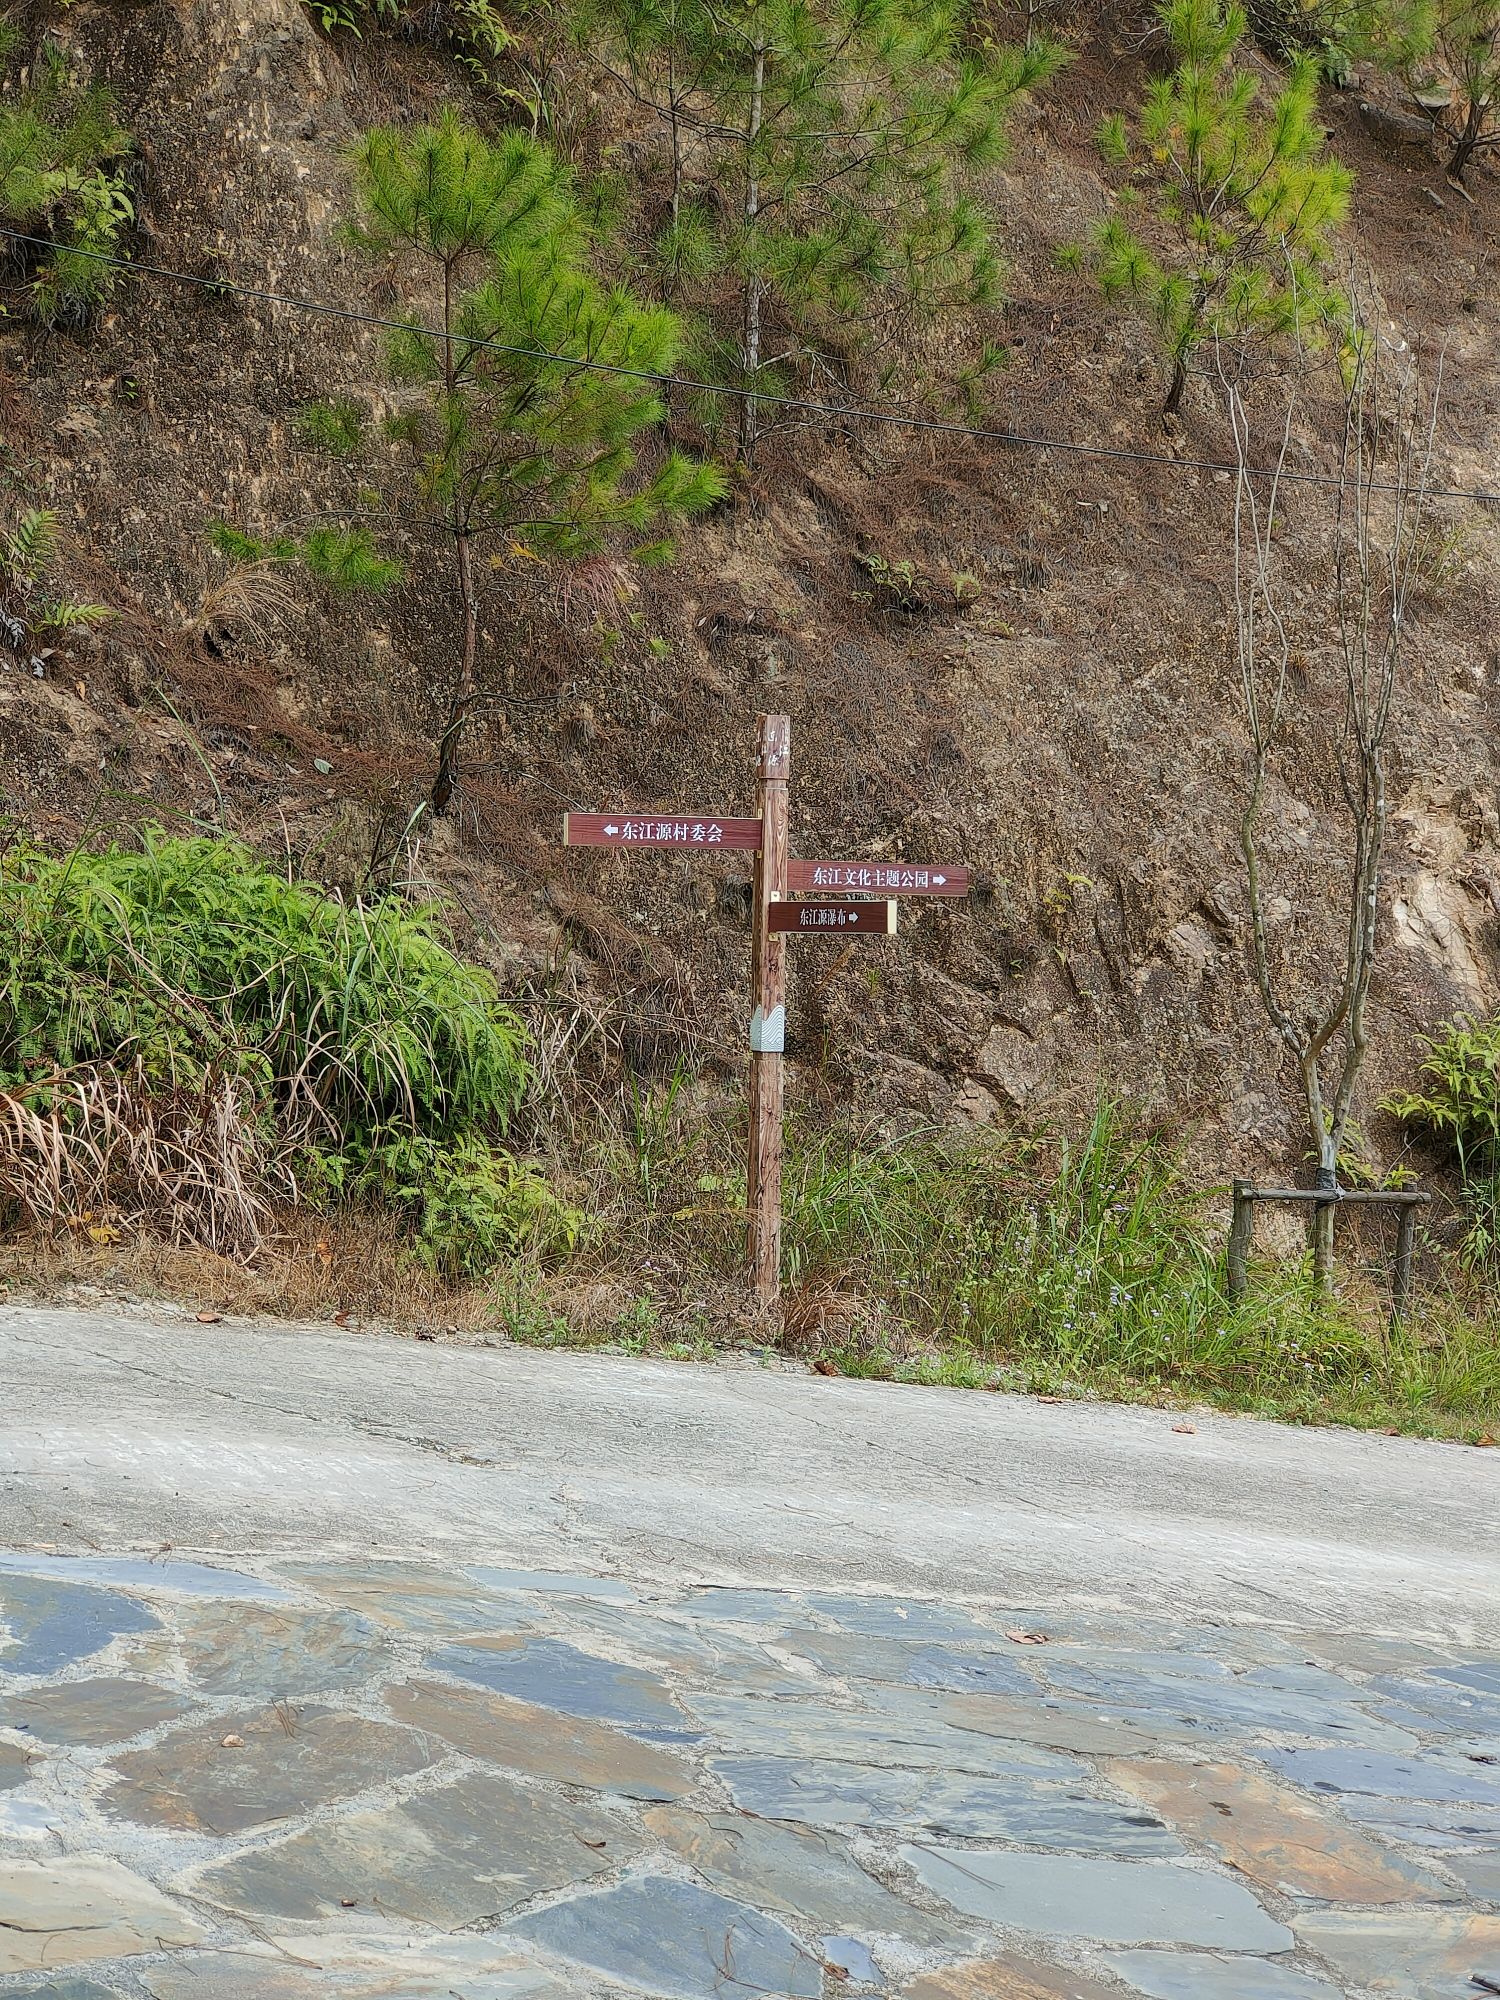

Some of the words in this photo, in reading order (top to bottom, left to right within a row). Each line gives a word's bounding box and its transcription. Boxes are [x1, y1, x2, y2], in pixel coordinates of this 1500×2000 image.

[621, 821, 723, 843] 东江源村委会
[813, 866, 928, 888] 东江文化主题公园
[799, 908, 846, 926] 东江源瀑布
